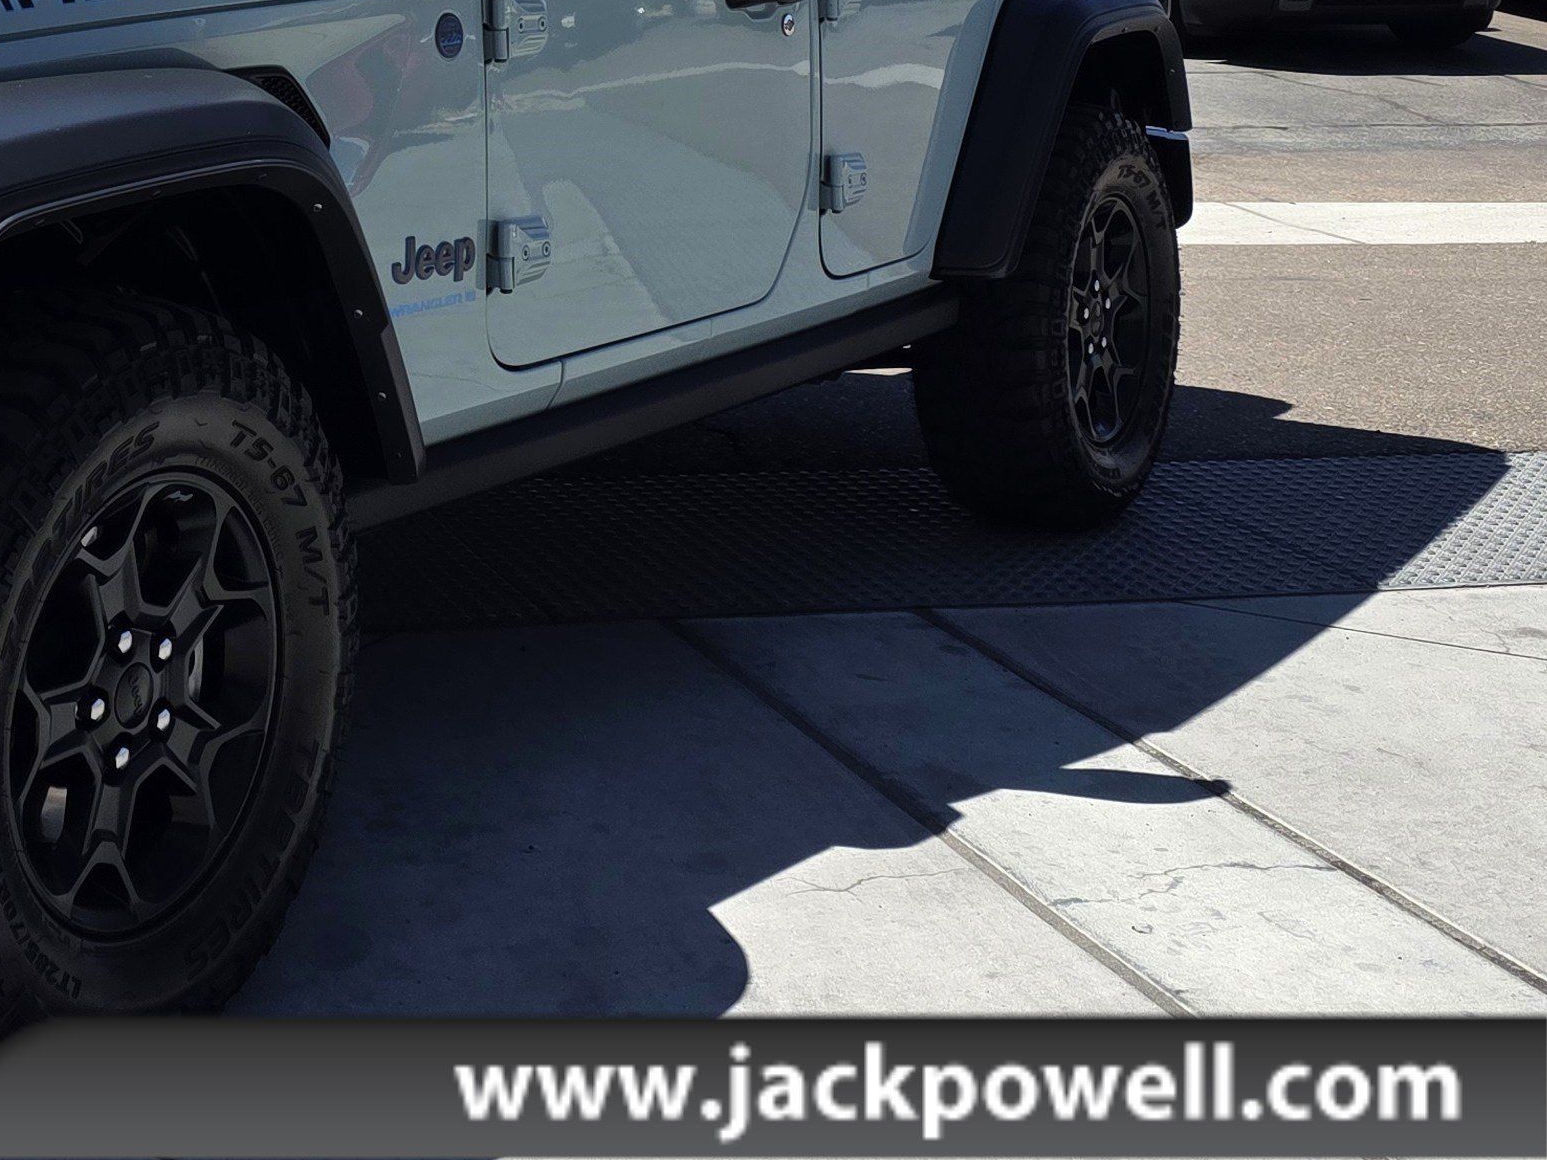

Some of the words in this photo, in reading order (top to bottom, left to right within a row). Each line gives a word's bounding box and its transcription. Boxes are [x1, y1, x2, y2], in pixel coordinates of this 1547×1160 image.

[391, 234, 477, 286] Jeep
[230, 419, 309, 507] TS-67
[295, 525, 331, 616] M/T
